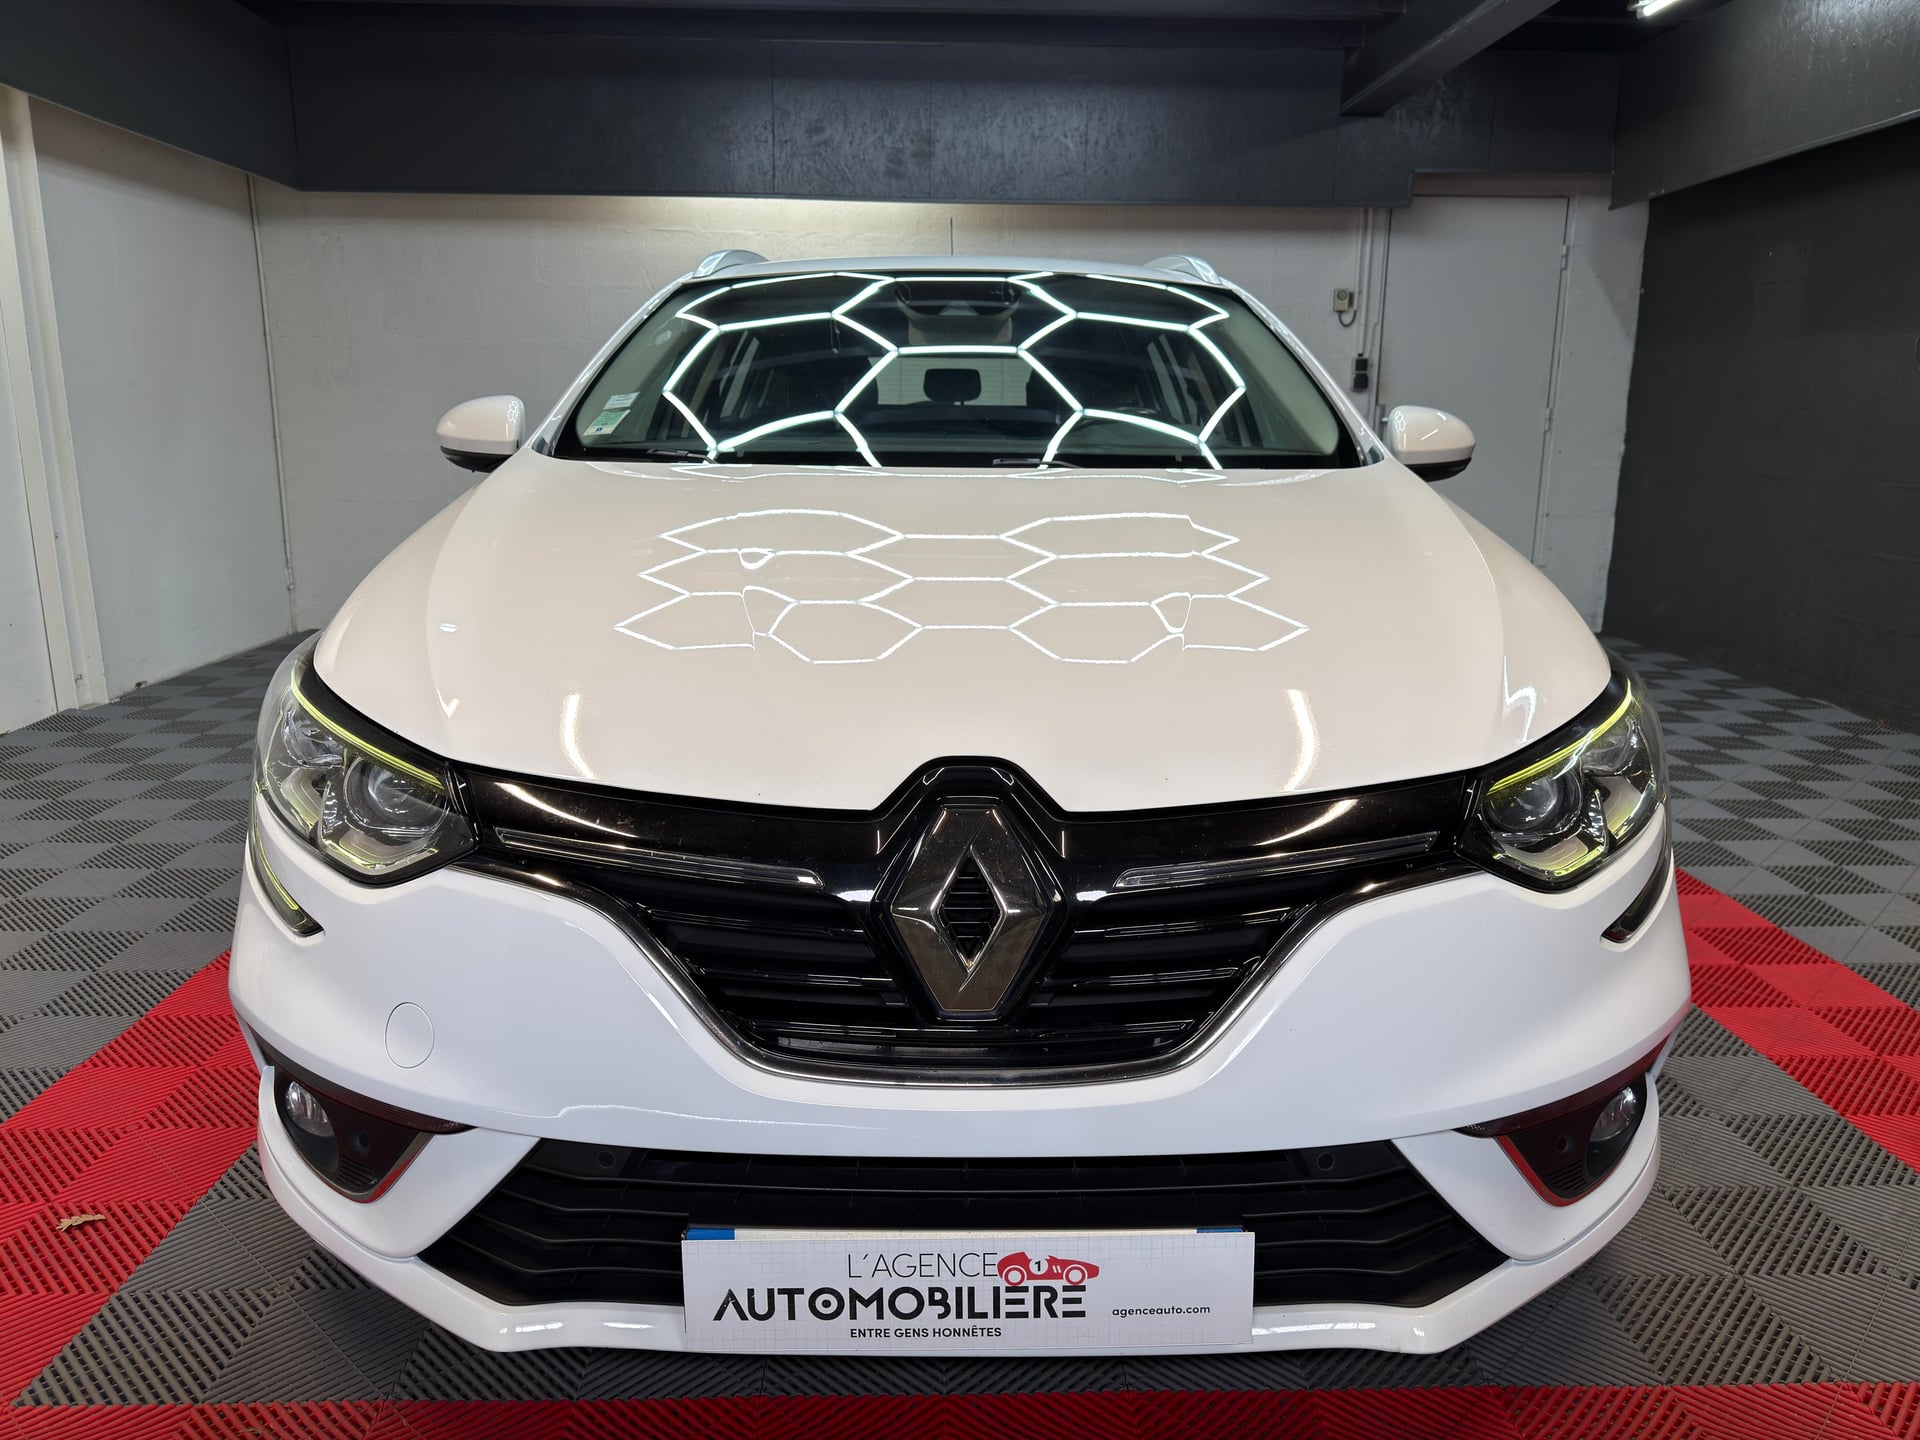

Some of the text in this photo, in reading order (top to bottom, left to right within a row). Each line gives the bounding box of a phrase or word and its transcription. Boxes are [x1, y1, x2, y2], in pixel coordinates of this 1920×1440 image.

[847, 1252, 998, 1278] L'AGENCE
[1034, 1260, 1041, 1272] 1
[1111, 1305, 1211, 1319] agenceauto.com
[850, 1325, 1002, 1339] ENTRE GENS HONNÊTES
